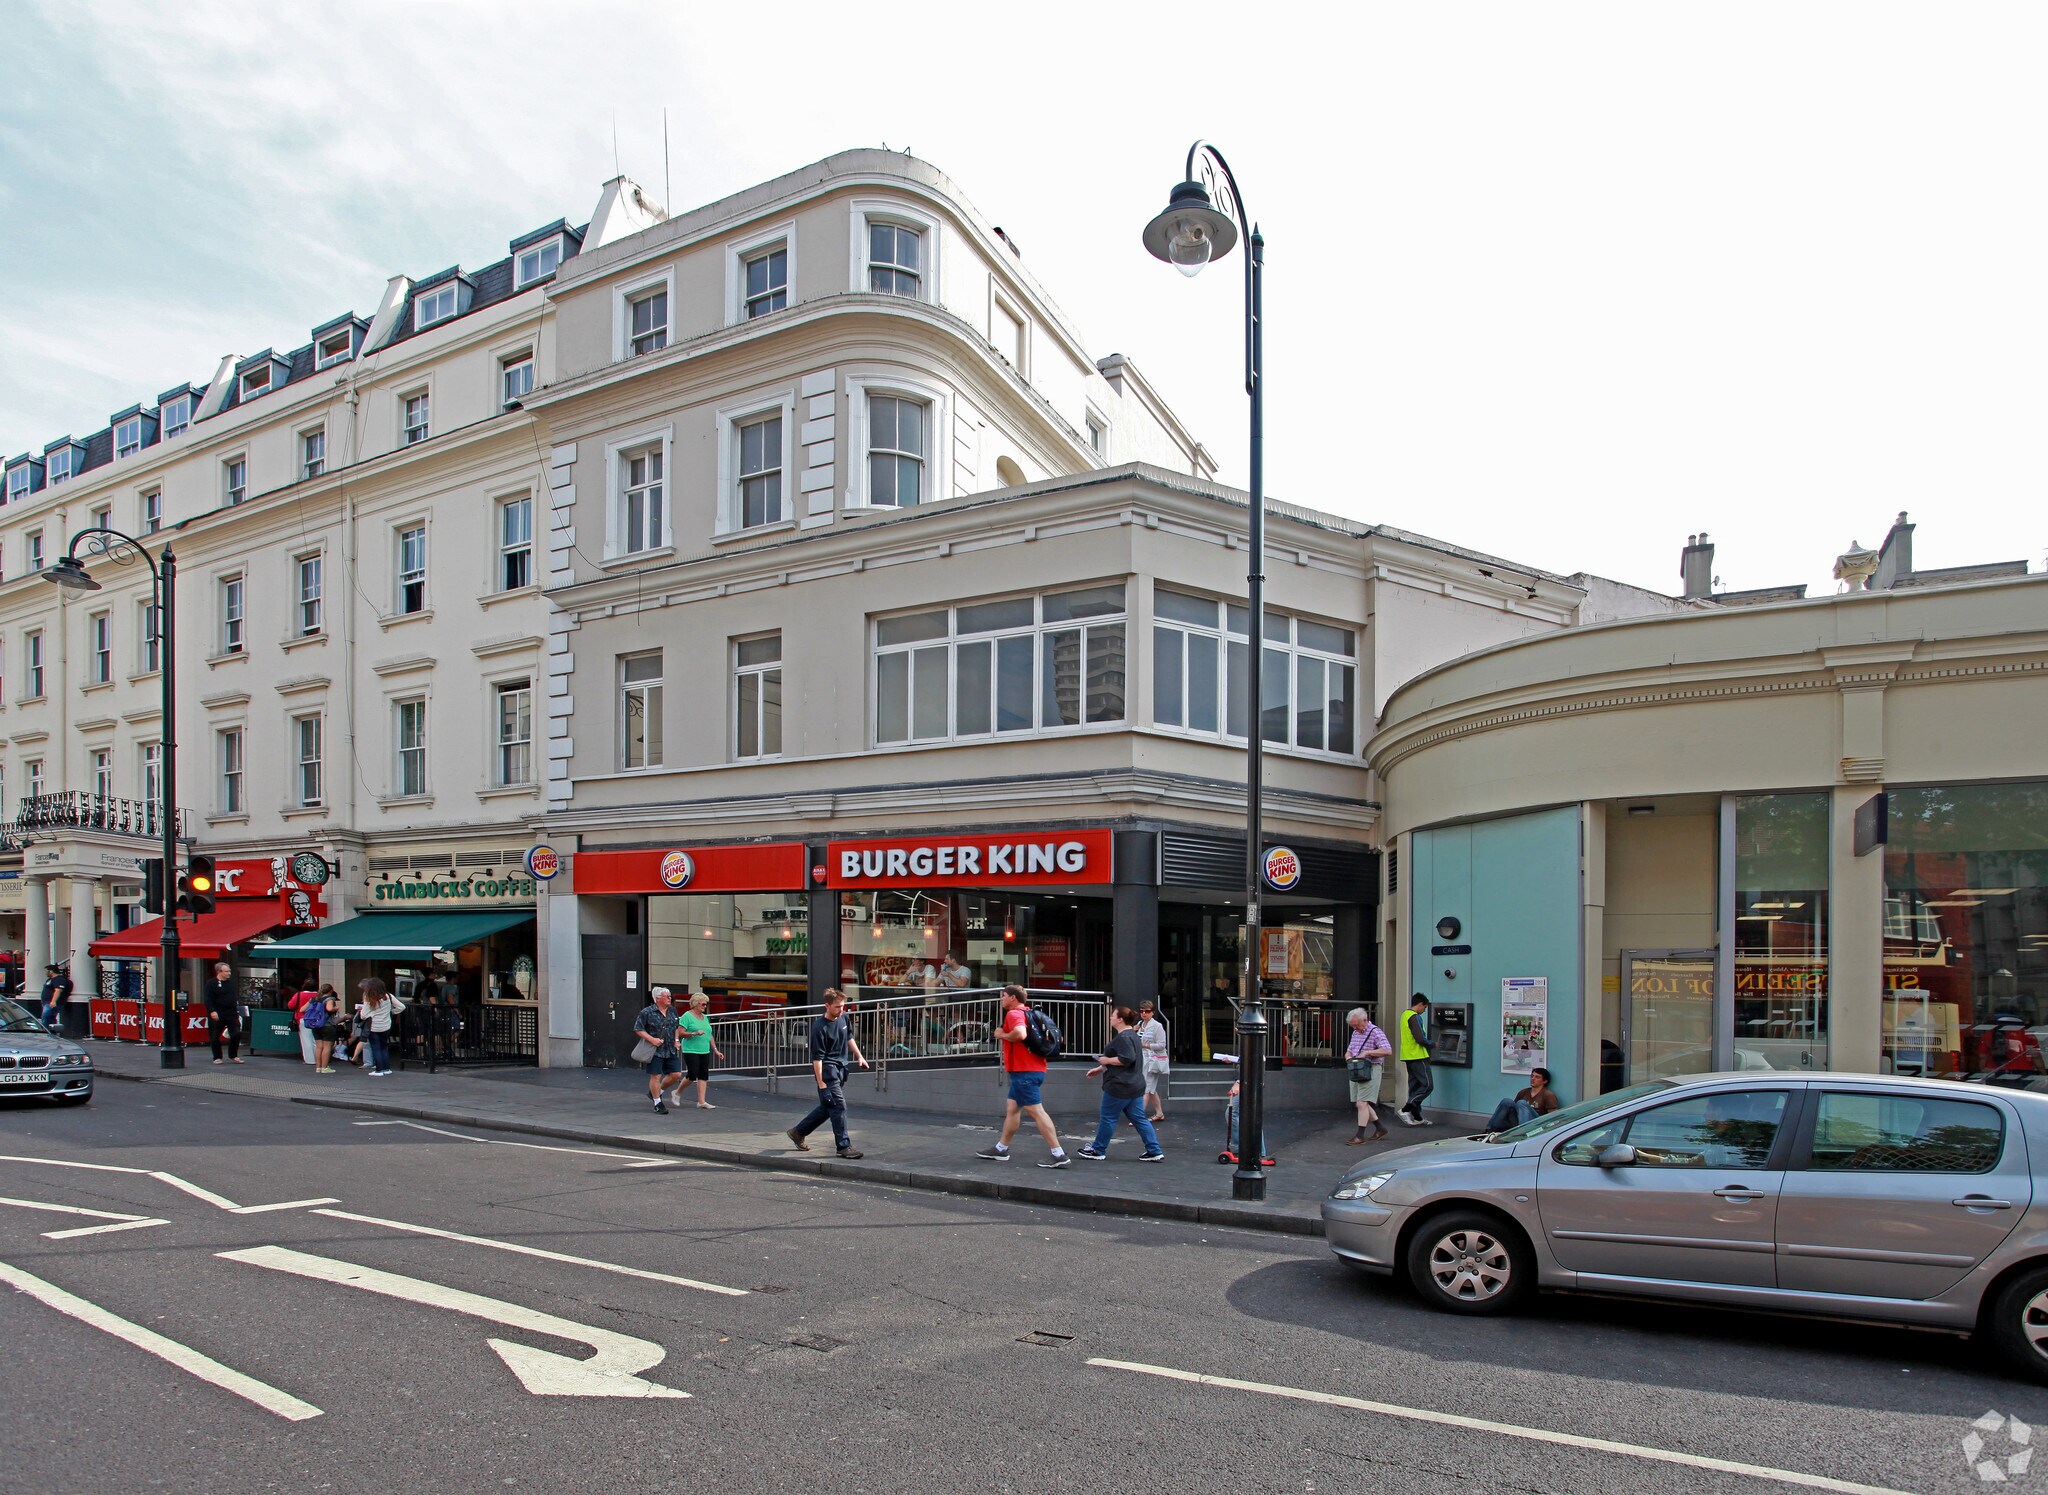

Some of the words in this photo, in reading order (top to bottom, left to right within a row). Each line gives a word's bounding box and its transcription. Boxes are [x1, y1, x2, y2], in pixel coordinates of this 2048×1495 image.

[532, 853, 557, 863] BURGER
[663, 857, 685, 873] BURGER
[841, 845, 983, 878] BURGER
[988, 841, 1087, 875] KING
[1267, 855, 1295, 869] BURGER
[533, 860, 558, 871] KING
[664, 863, 686, 880] KING
[1268, 863, 1297, 880] KING
[0, 882, 22, 891] ISSERIE
[215, 869, 244, 892] FC
[375, 880, 471, 901] STARBUCKS
[94, 1012, 113, 1025] KFC
[119, 1013, 138, 1027] KFC
[28, 1074, 47, 1082] XKN
